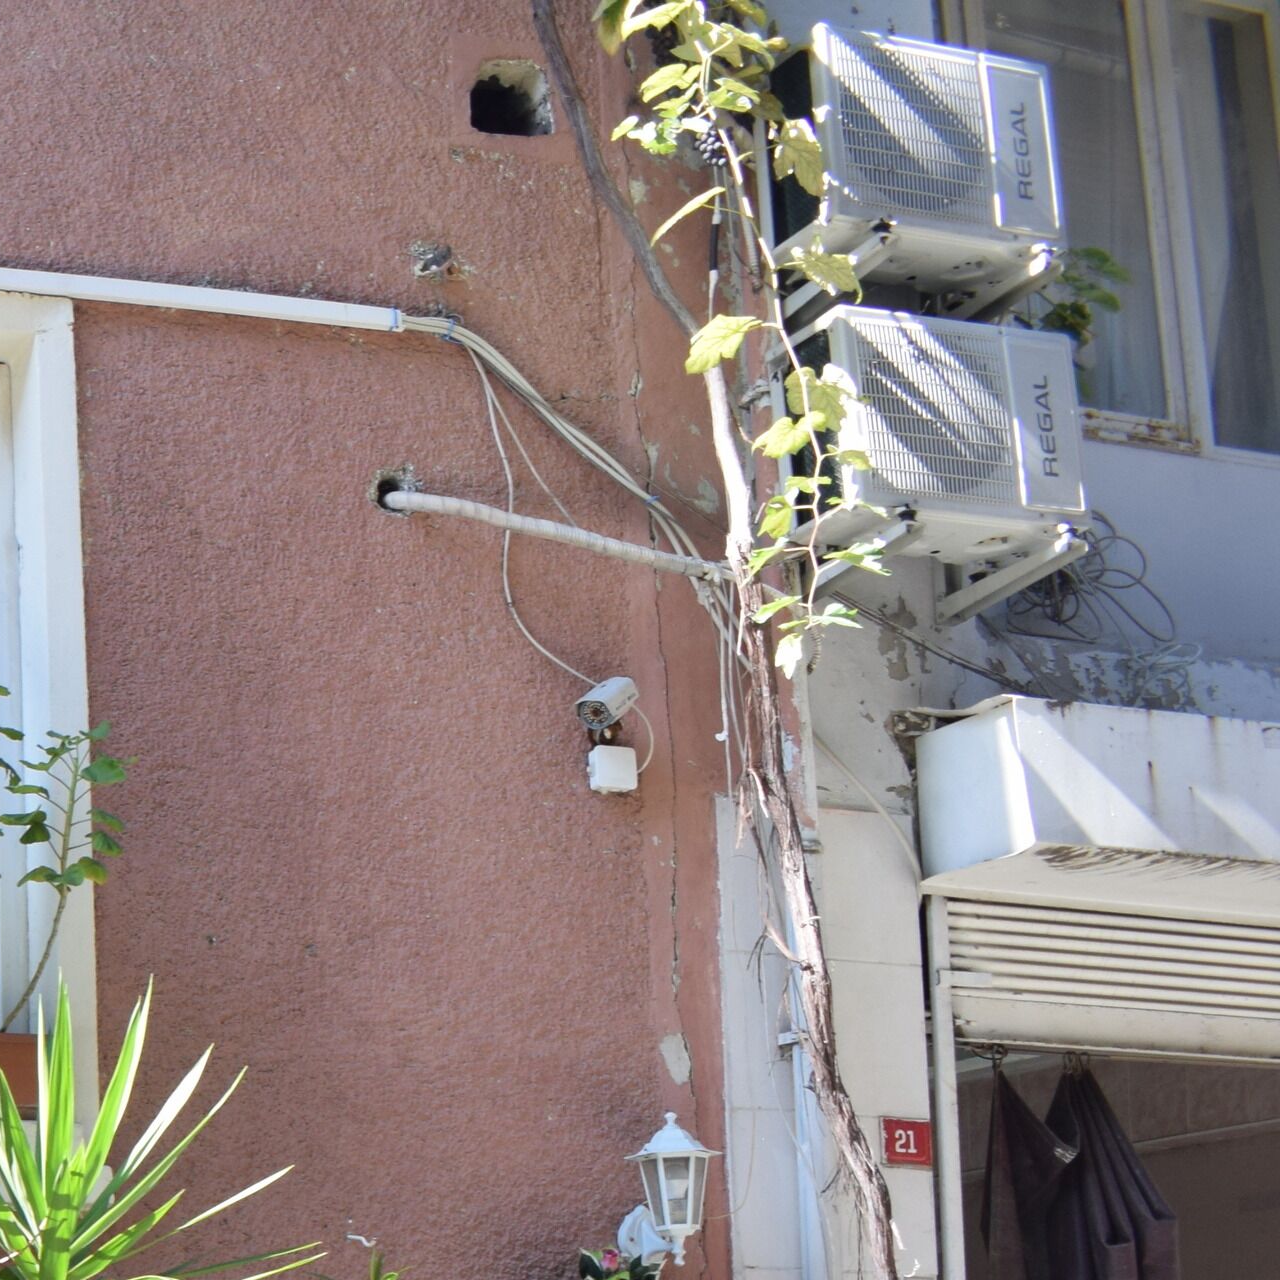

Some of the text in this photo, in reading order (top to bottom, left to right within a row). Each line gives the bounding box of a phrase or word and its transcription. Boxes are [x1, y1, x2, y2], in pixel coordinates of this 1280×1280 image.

[1010, 102, 1033, 200] REGAL
[1033, 375, 1059, 477] REGAL
[895, 1129, 917, 1153] 21
